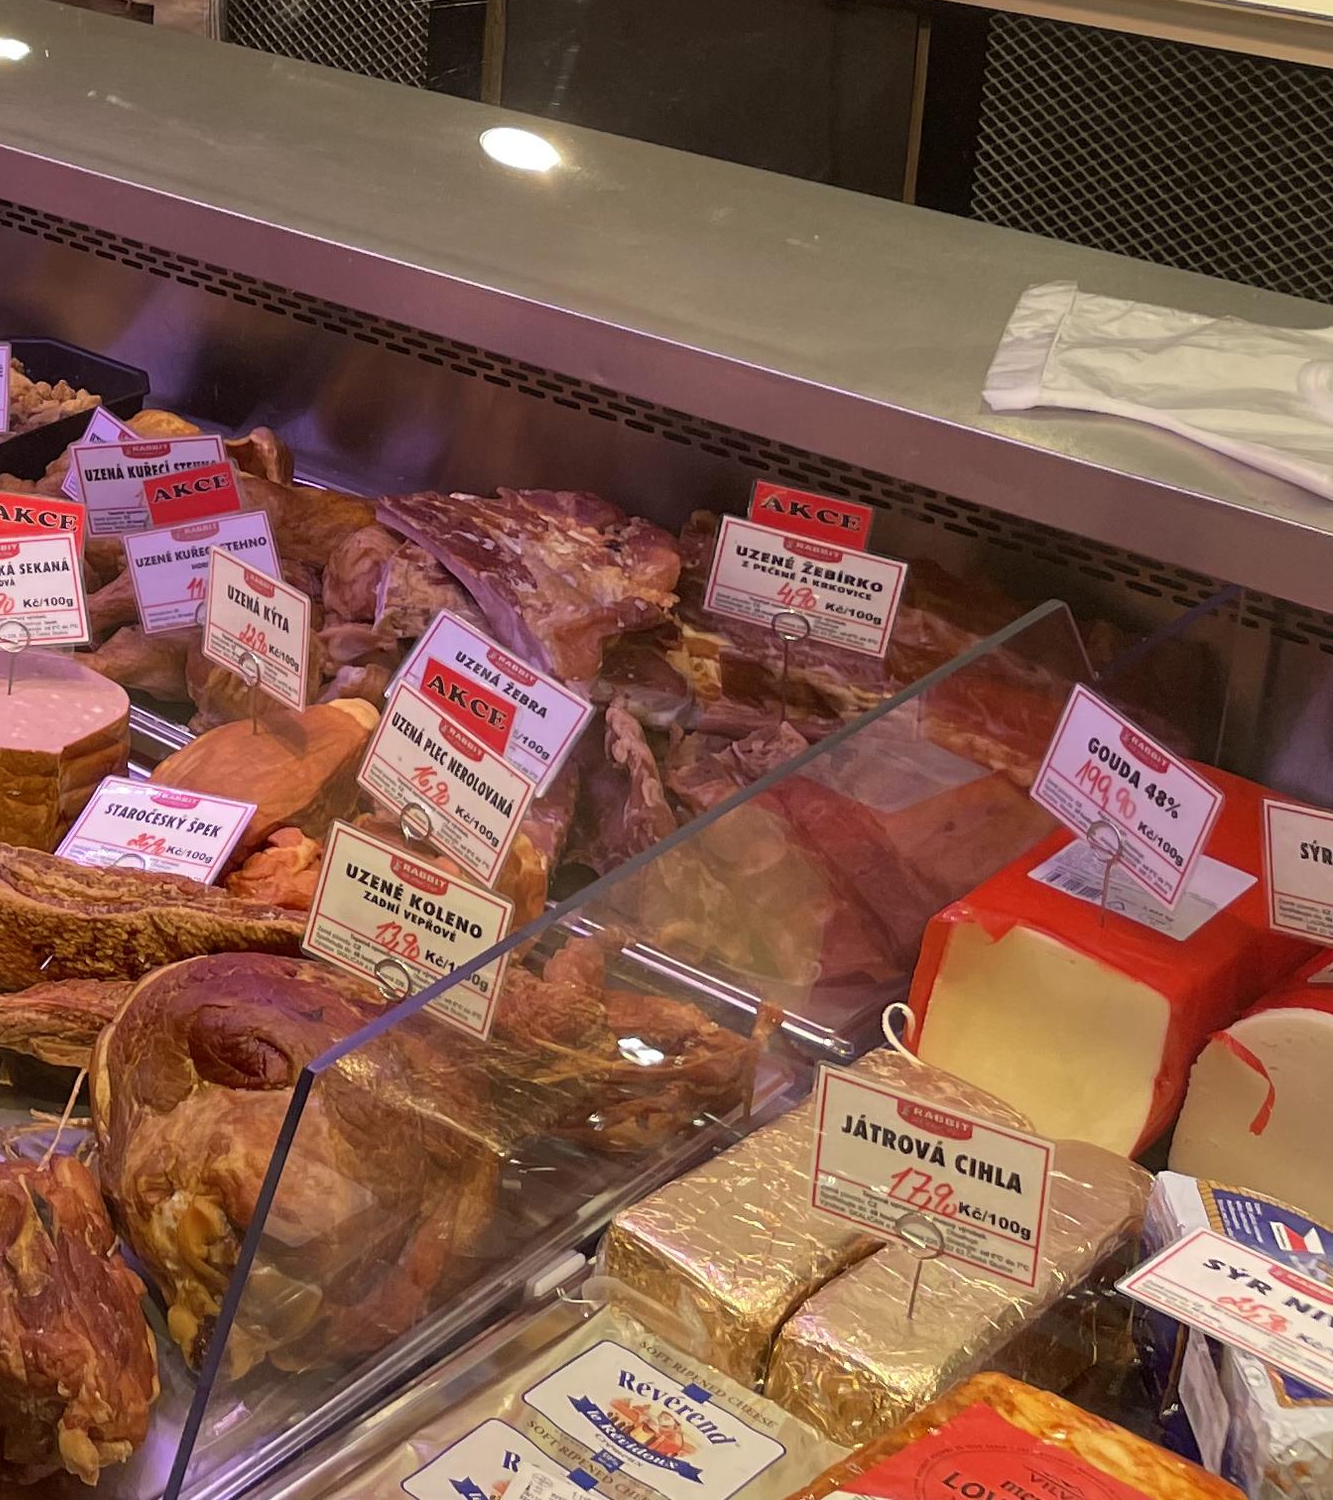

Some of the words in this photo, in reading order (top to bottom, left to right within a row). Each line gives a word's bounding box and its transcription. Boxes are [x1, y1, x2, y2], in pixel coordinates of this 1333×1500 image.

[85, 466, 124, 481] UZENÁ
[128, 460, 171, 479] KUŘECÍ
[153, 472, 229, 504] AKCE
[760, 494, 862, 532] AKCE
[19, 558, 70, 575] SEKANÁ
[135, 550, 172, 568] UZENÉ
[736, 545, 794, 570] UZENÉ
[801, 561, 883, 593] ŽEBÍRKO
[23, 595, 74, 609] Kč/100g
[753, 562, 796, 582] PEČENÉ
[800, 576, 808, 584] A
[812, 579, 872, 601] KRKOVICE
[227, 584, 259, 617] UZENÁ
[263, 601, 291, 634] KÝTA
[825, 602, 882, 626] Kč/100g
[268, 644, 301, 672] Kč/100g
[496, 653, 536, 686] RABBIT
[427, 674, 508, 731] AKCE
[455, 650, 501, 688] UZENÁ
[502, 679, 548, 720] ŽEBRA
[391, 711, 424, 748] UZENÁ
[423, 736, 448, 765] PLEC
[447, 750, 515, 819] NEROLOVANÁ
[1087, 737, 1141, 789] GOUDA
[1145, 782, 1182, 819] 48%
[104, 802, 186, 833] STAROČESKÝ
[189, 816, 222, 838] ŠPEK
[454, 805, 499, 848] Kč/100g
[166, 843, 213, 865] Kč/100g
[1137, 821, 1184, 867] Kč/100g
[402, 861, 447, 889] RABBIT
[345, 863, 406, 901] UZENÉ
[409, 892, 483, 940] KOLENO
[363, 890, 400, 916] ZADNÍ
[403, 910, 457, 943] VEPŘOVÉ
[841, 1112, 947, 1168] JÁTROVÁ
[954, 1152, 1023, 1194] CIHLA
[957, 1200, 1033, 1242] Kč/100g
[1202, 1257, 1273, 1297] SÝR
[638, 1340, 672, 1366] SOFT
[671, 1360, 727, 1398] RIPENED
[617, 1368, 738, 1448] Révérend
[528, 1419, 559, 1447] SOFT
[559, 1444, 616, 1486] RIPENED
